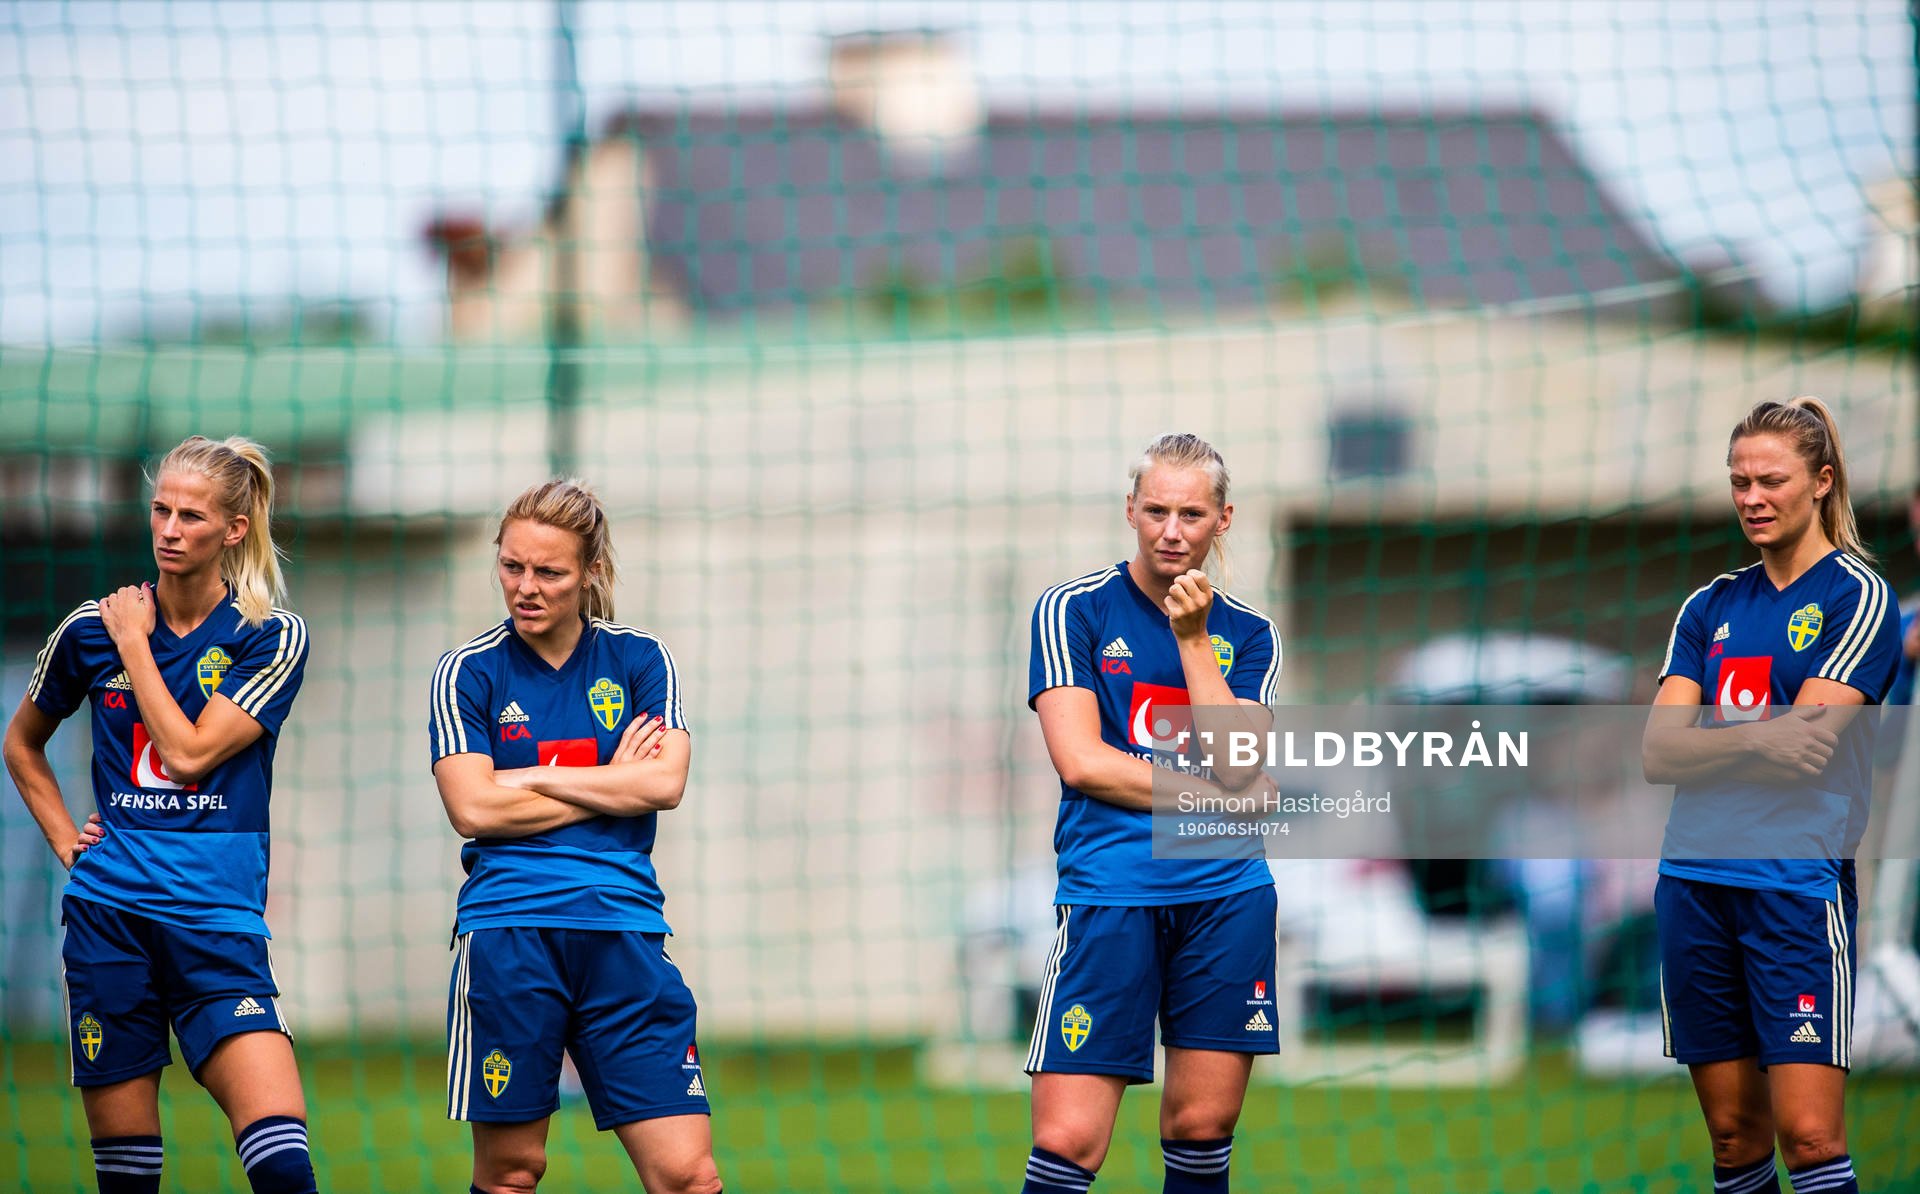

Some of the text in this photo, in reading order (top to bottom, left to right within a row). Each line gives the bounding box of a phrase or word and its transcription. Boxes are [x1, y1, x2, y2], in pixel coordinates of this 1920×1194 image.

[1103, 650, 1133, 658] adidas
[1101, 658, 1132, 675] ICA
[104, 691, 127, 709] ICA
[499, 714, 530, 724] adidas
[501, 724, 532, 742] ICA
[187, 795, 228, 810] SPEL
[234, 1007, 266, 1016] adidas
[1245, 1023, 1273, 1032] adidas
[1790, 1035, 1821, 1043] adidas
